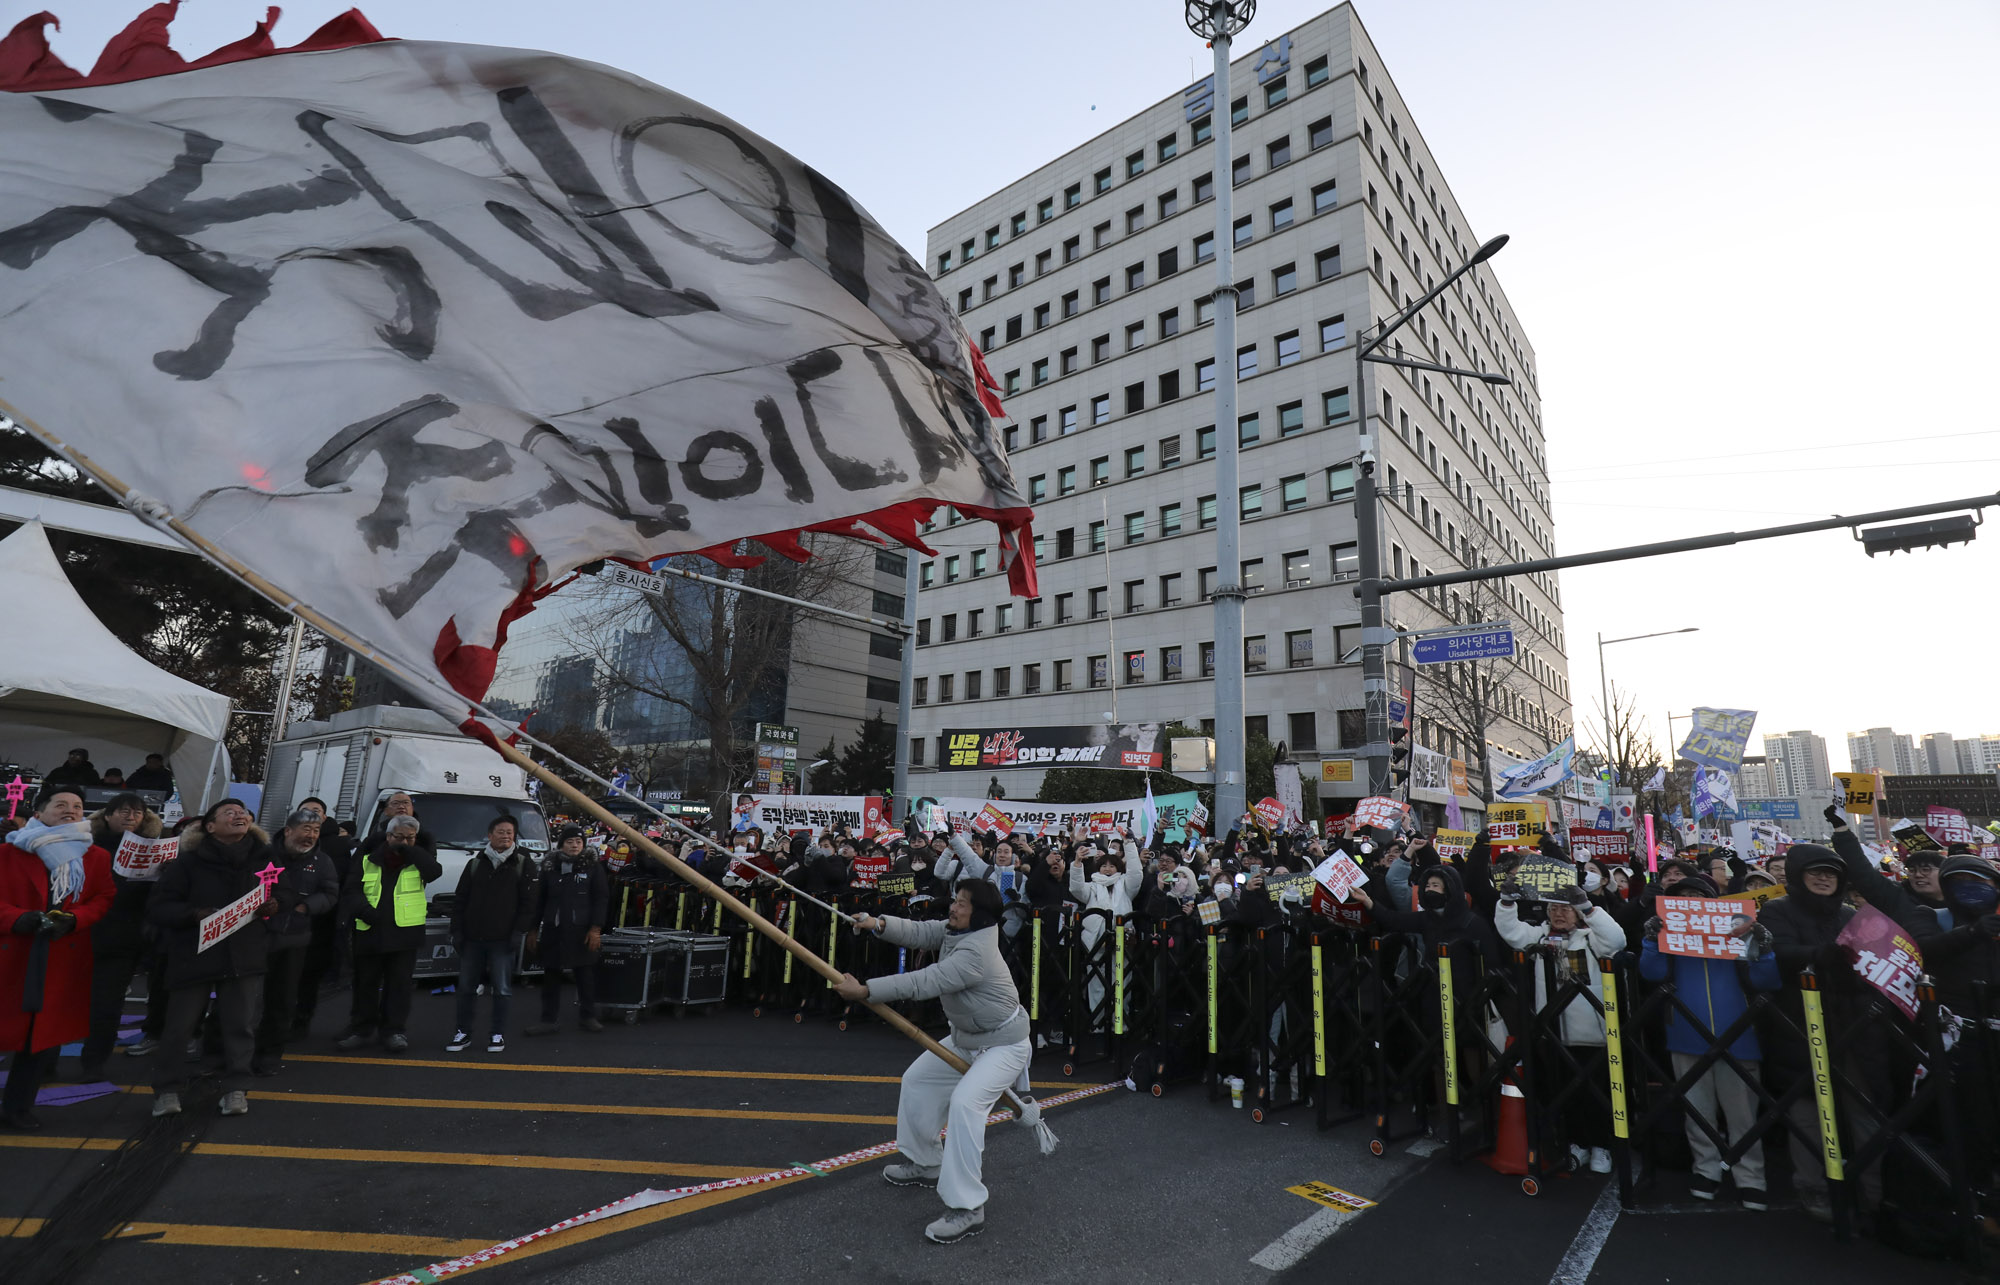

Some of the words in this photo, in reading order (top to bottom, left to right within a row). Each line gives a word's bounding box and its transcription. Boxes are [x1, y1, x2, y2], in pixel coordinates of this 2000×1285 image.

[615, 571, 661, 593] 동시신호
[1448, 635, 1510, 649] 의사당대로
[1448, 647, 1510, 658] Uisadang-daero
[948, 734, 980, 750] 내란
[984, 731, 1025, 757] 내란
[949, 750, 980, 766] 공범
[1057, 745, 1106, 762] 해체!
[1124, 753, 1151, 765] 진보당
[649, 792, 681, 800] STARBUCKS
[762, 808, 782, 824] 즉각
[1356, 805, 1393, 819] 윤석열
[1486, 809, 1527, 822] 윤석열을
[1371, 816, 1395, 829] 구속
[1489, 822, 1546, 839] 탄핵하라
[122, 840, 149, 854] 내란범
[150, 841, 178, 853] 윤석열
[1435, 834, 1474, 846] 윤석열을
[117, 850, 177, 869] 체포하라
[879, 884, 893, 893] 즉각
[893, 883, 915, 895] 탄핵
[1537, 872, 1577, 892] 탄핵
[204, 908, 234, 930] 내란범
[236, 889, 261, 911] 윤석열
[1320, 899, 1361, 924] 탄핵
[1664, 899, 1702, 911] 반민주
[1704, 901, 1742, 913] 반헌법
[202, 898, 262, 944] 체포하라
[1666, 912, 1733, 934] 윤석열
[1666, 934, 1704, 954] 탄핵
[1707, 936, 1747, 957] 구속
[1887, 948, 1922, 979] 윤석
[1441, 984, 1450, 1040] POLICE
[1444, 1050, 1453, 1089] LINE
[1605, 1001, 1625, 1121] 질서유지선
[1811, 1023, 1828, 1096] POLICE
[1820, 1109, 1837, 1160] LINE
